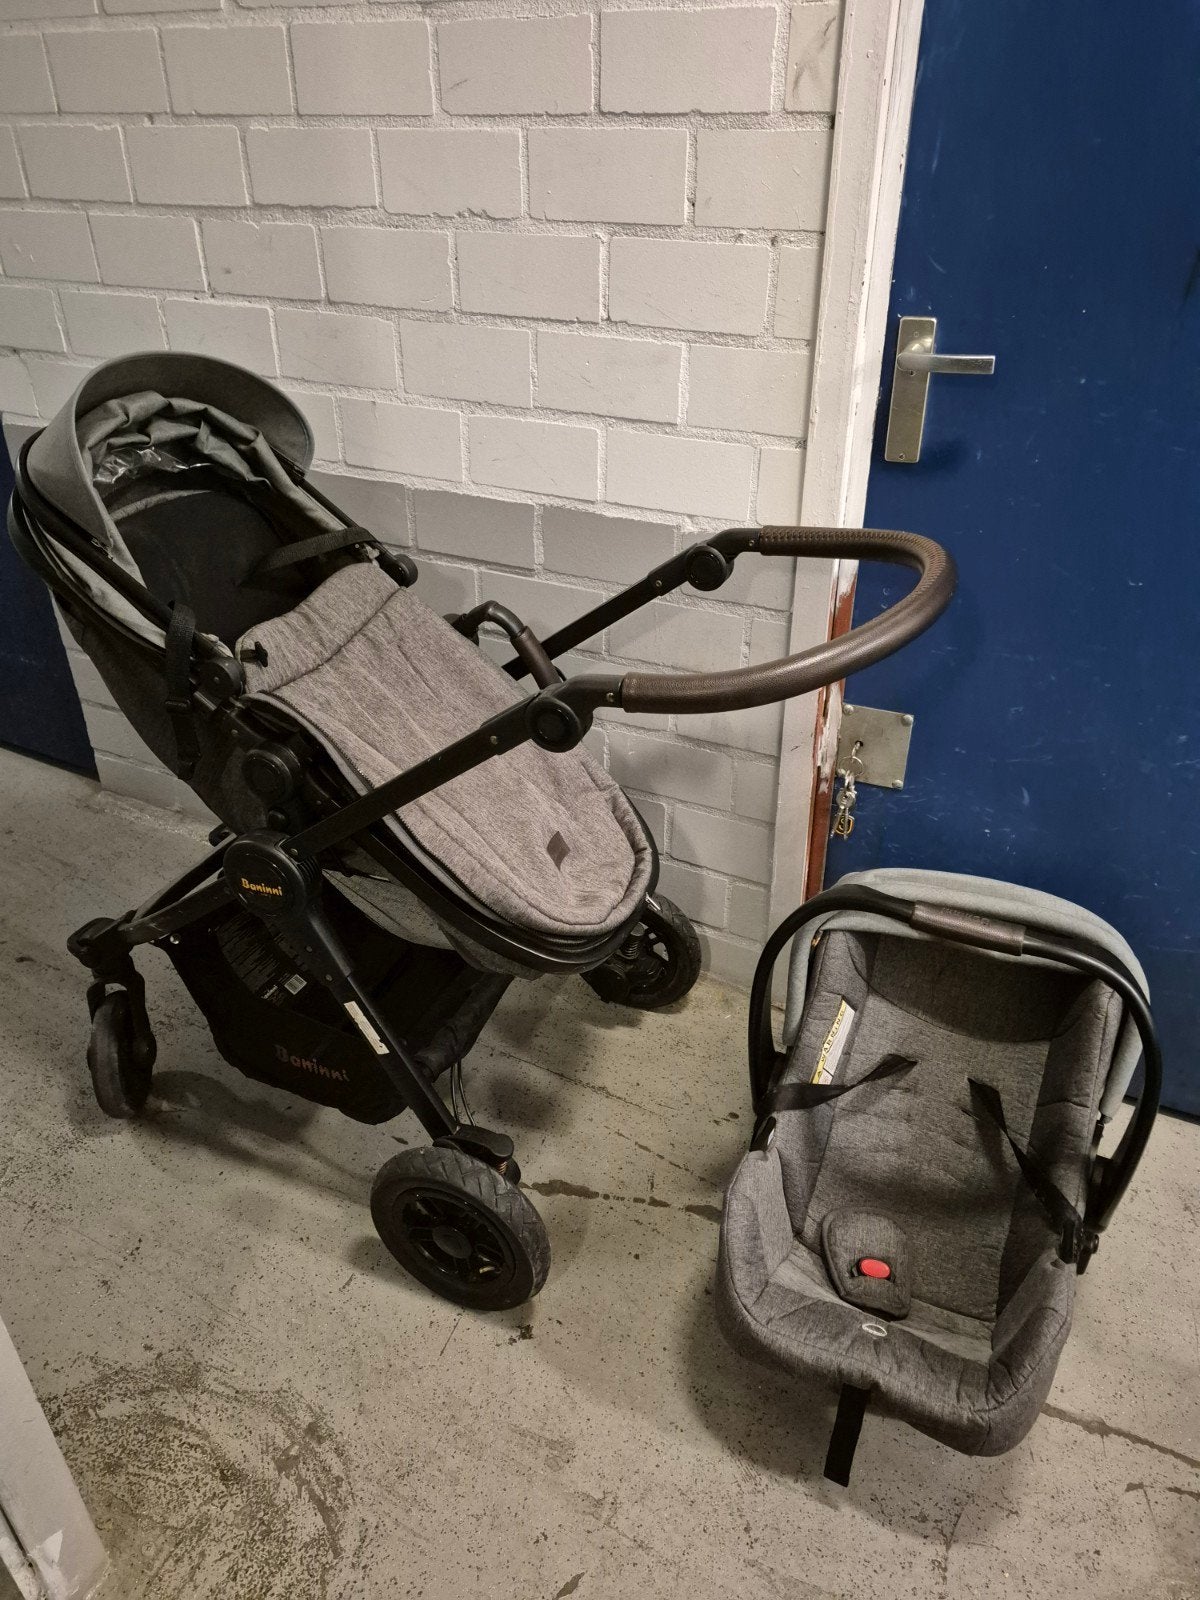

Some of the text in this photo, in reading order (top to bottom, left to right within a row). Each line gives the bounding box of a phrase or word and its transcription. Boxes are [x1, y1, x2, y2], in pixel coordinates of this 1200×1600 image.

[241, 877, 283, 897] Baninni
[821, 1009, 844, 1062] WARNING
[272, 1044, 350, 1082] Baninni
